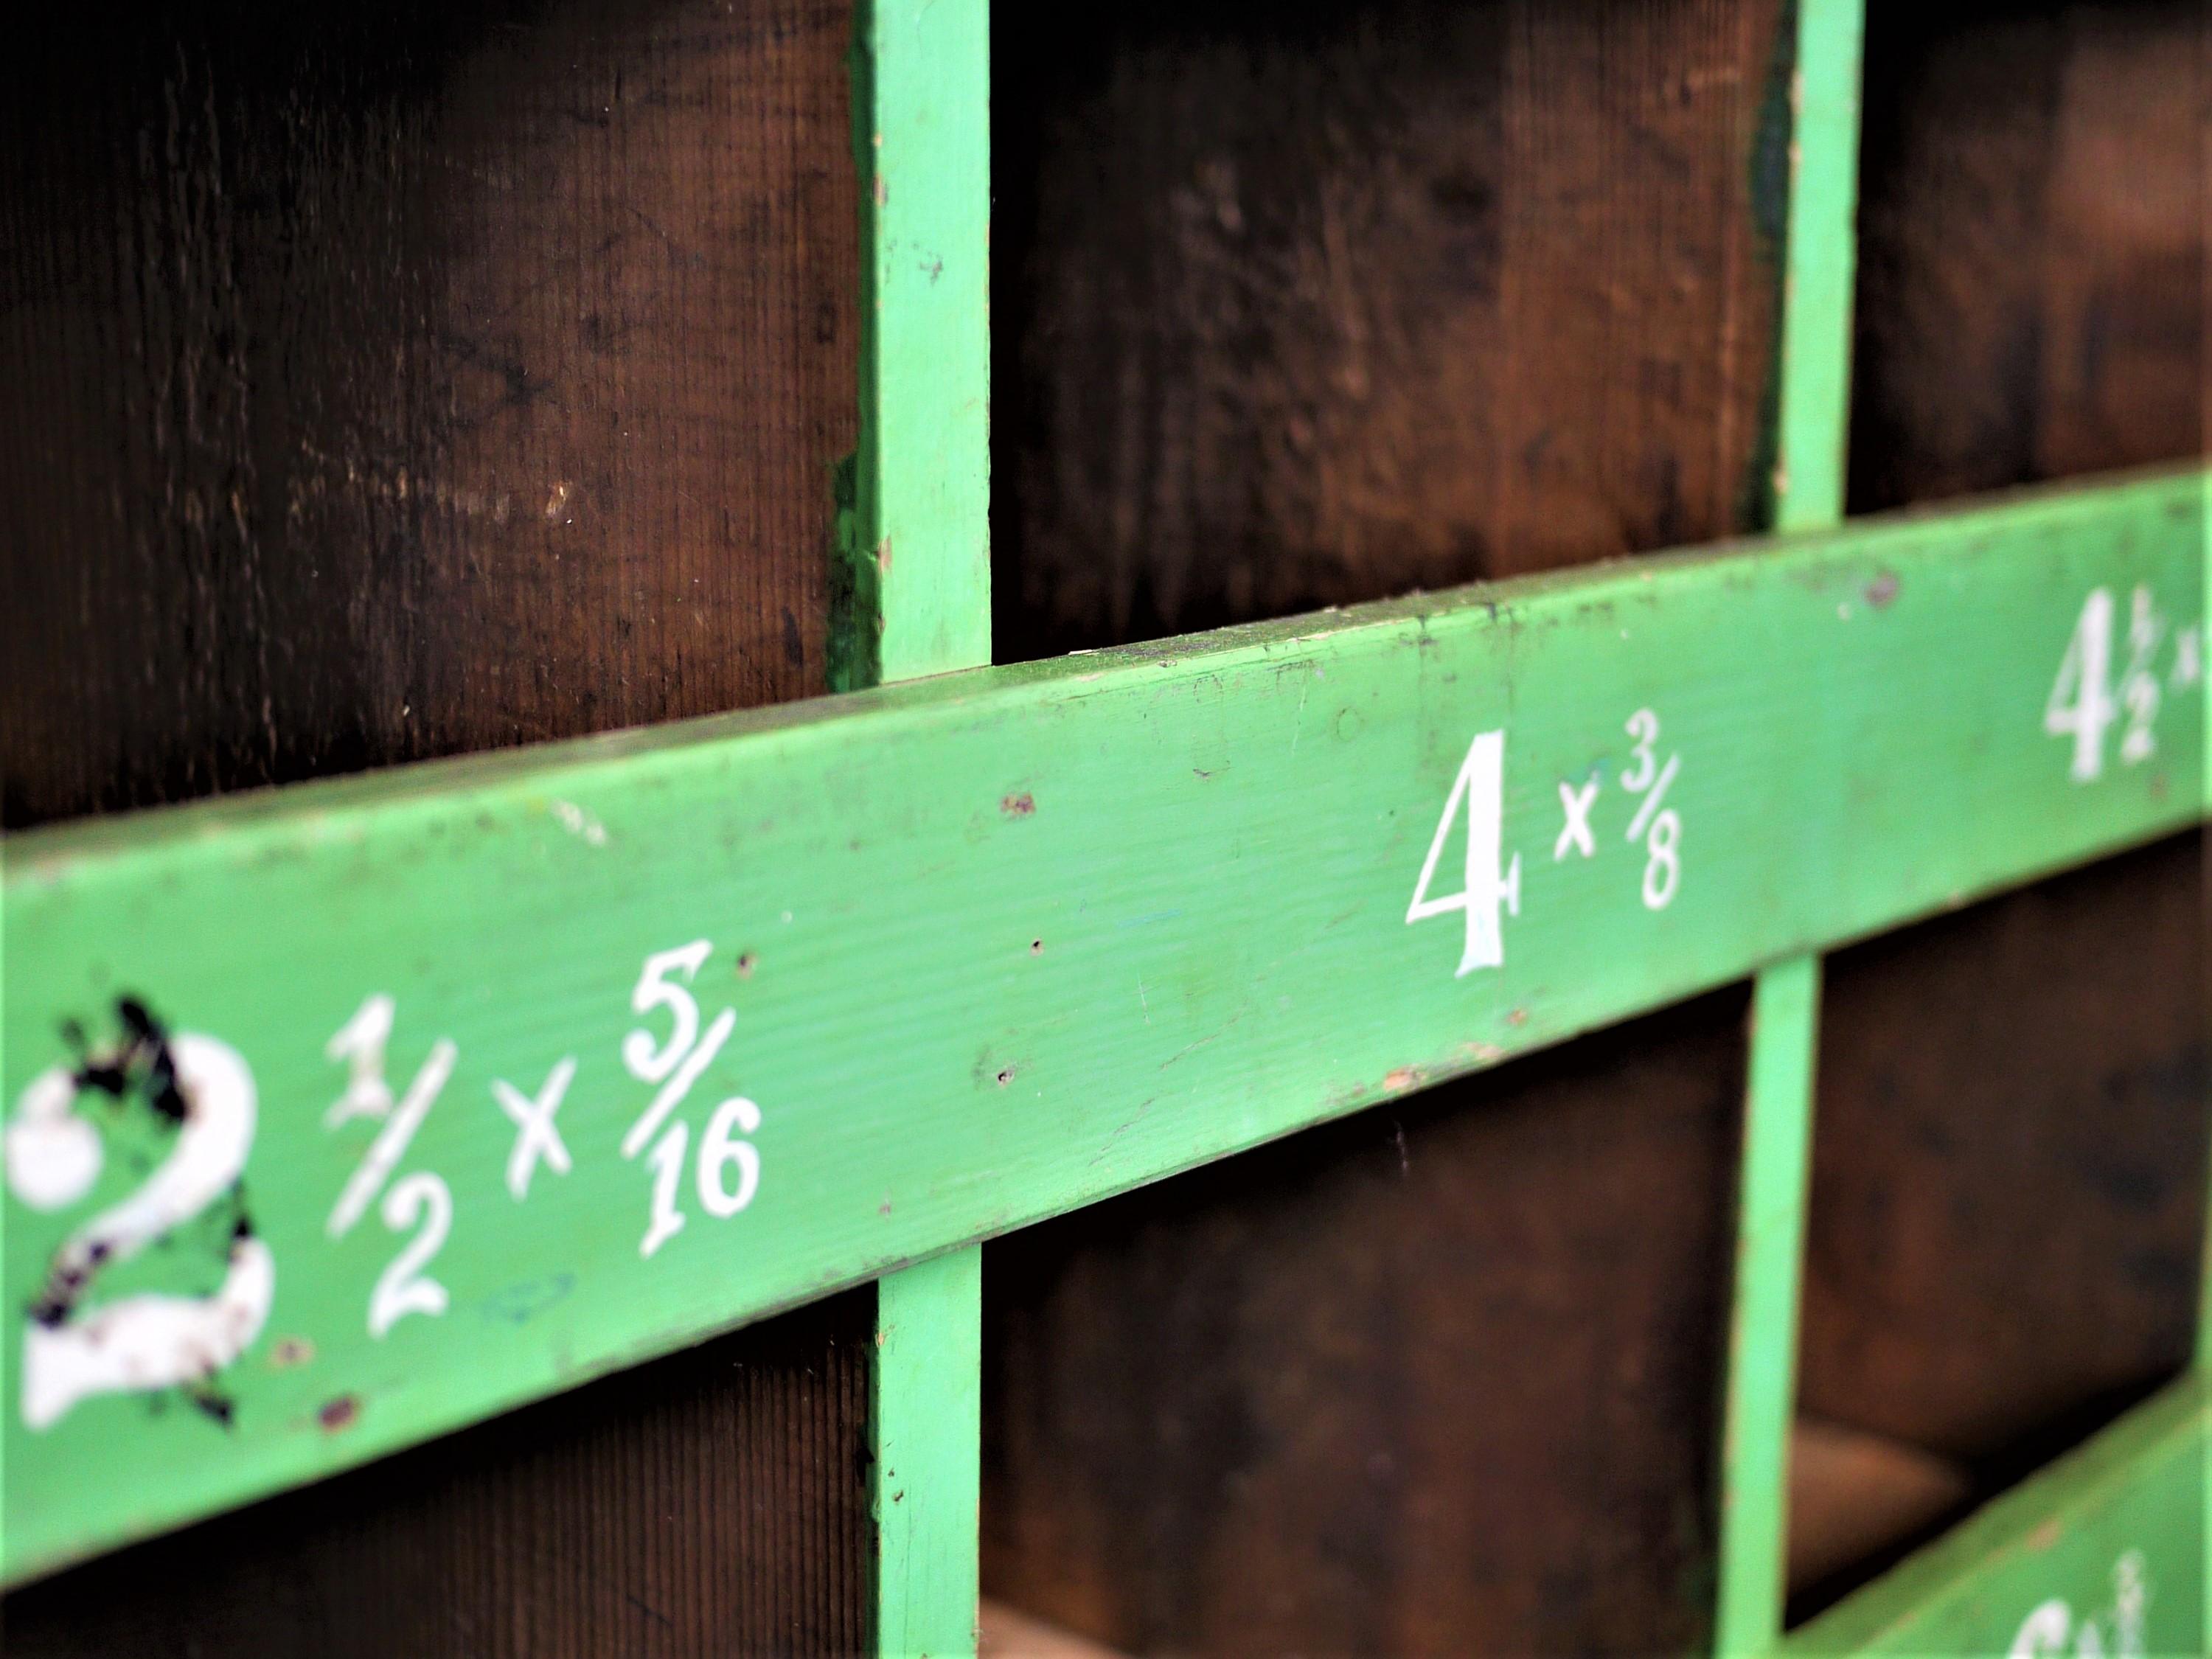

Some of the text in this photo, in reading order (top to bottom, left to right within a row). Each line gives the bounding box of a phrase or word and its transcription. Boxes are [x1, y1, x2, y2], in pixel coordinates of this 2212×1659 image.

[2044, 586, 2117, 782] 4
[1405, 729, 1521, 979] 4
[1620, 707, 1681, 911] 3/8
[4, 1031, 274, 1429] 2
[324, 993, 457, 1338] 1/2
[621, 939, 761, 1258] 5/16
